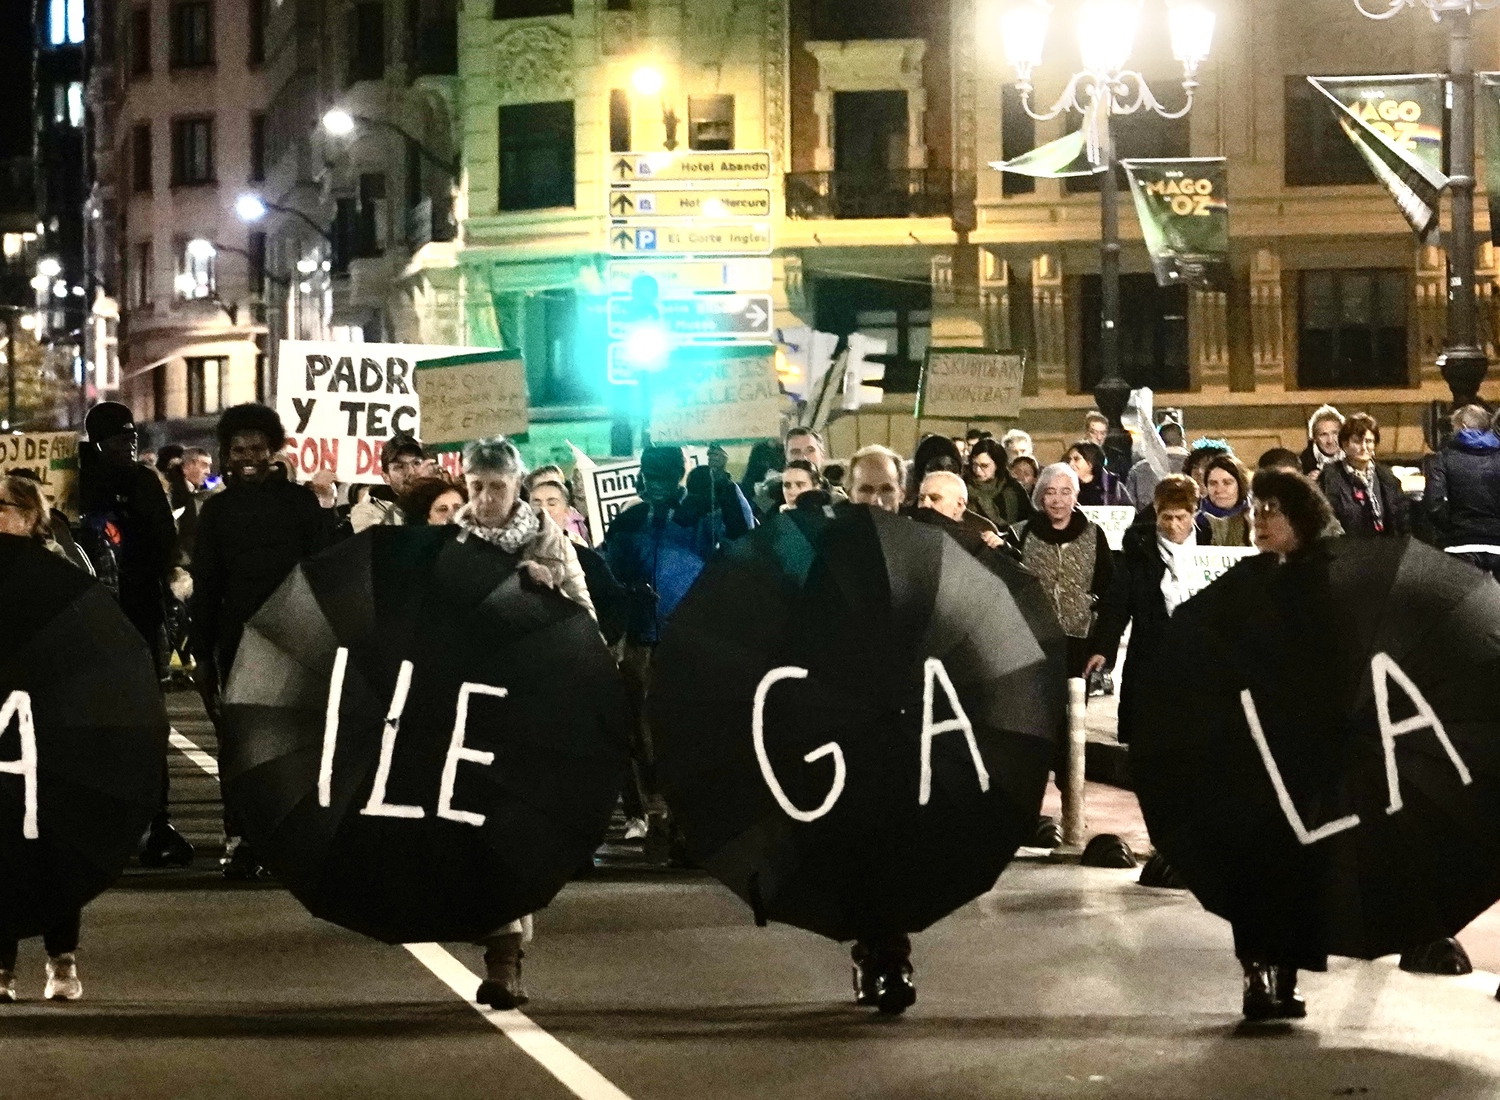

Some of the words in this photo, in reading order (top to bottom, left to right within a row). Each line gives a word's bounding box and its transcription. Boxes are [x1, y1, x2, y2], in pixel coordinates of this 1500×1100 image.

[680, 162, 715, 172] Hotel
[720, 162, 767, 172] Abando
[1145, 178, 1213, 195] MAGO
[1171, 194, 1211, 216] OZ
[306, 354, 419, 394] PADR
[292, 397, 316, 434] Y
[25, 438, 48, 460] DE
[601, 470, 636, 493] nin
[317, 646, 508, 826] ILE
[752, 657, 990, 822] GA
[1240, 652, 1472, 844] LA
